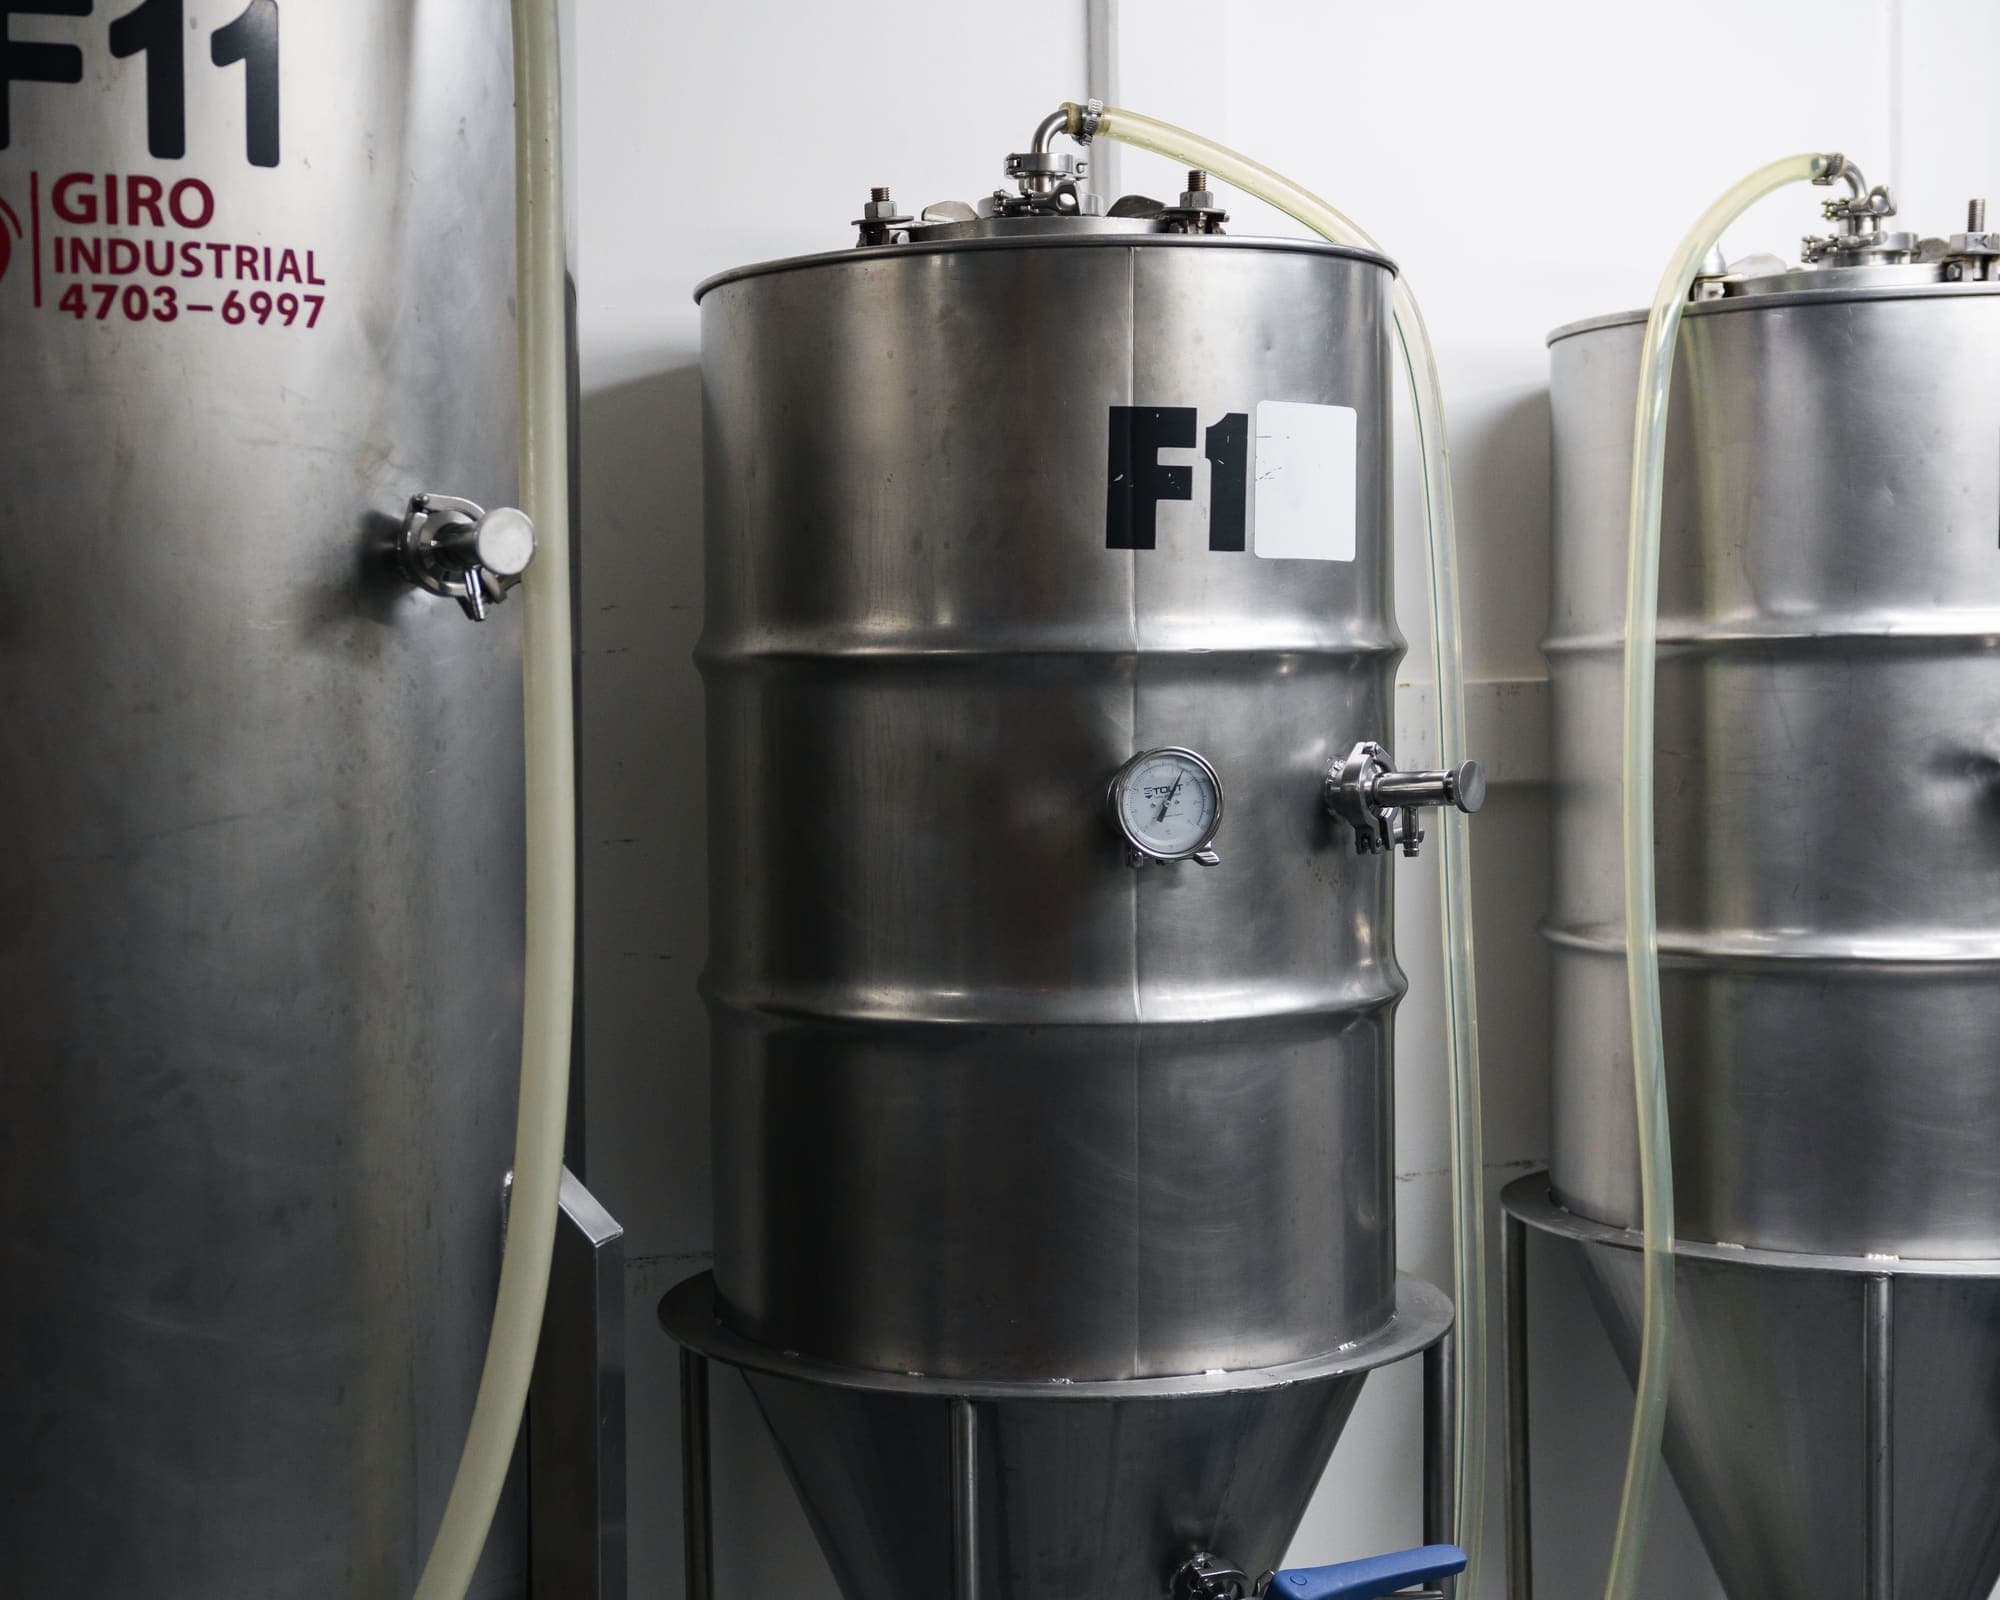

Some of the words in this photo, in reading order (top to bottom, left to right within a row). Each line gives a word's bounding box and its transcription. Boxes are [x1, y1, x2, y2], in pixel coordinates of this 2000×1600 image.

[0, 0, 280, 168] F11
[51, 172, 215, 229] GIRO
[54, 236, 326, 286] INDUSTRIAL
[1105, 406, 1248, 552] F1
